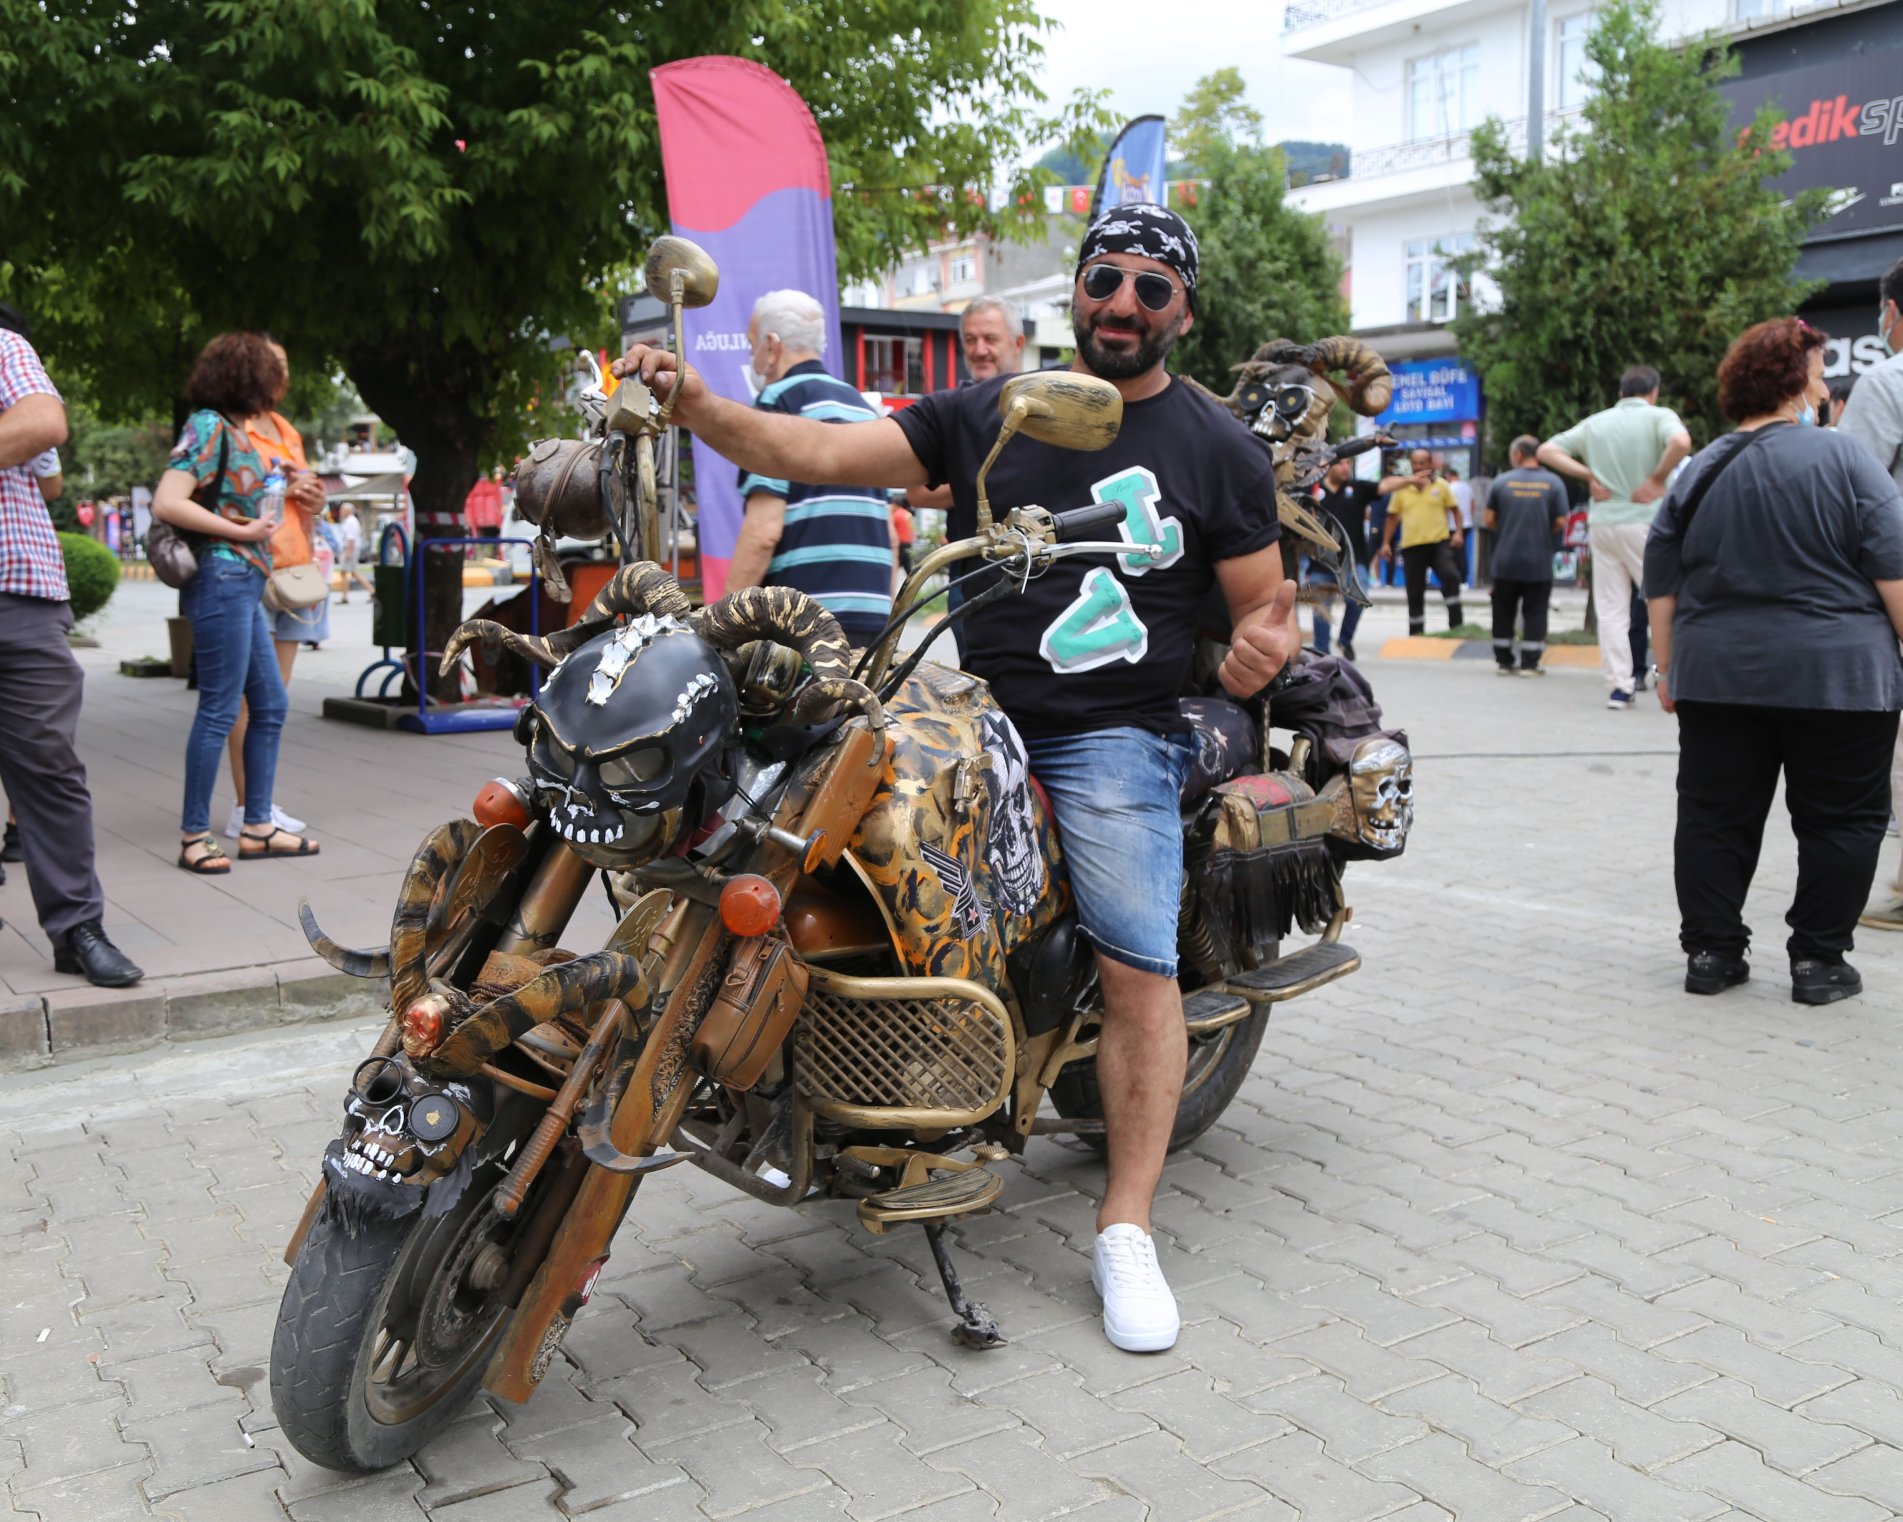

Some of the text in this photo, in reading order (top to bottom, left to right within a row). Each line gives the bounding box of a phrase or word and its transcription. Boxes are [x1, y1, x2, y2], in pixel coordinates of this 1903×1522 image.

[1822, 334, 1887, 379] as
[1392, 371, 1427, 390] EMEL
[1394, 400, 1424, 414] LOTO
